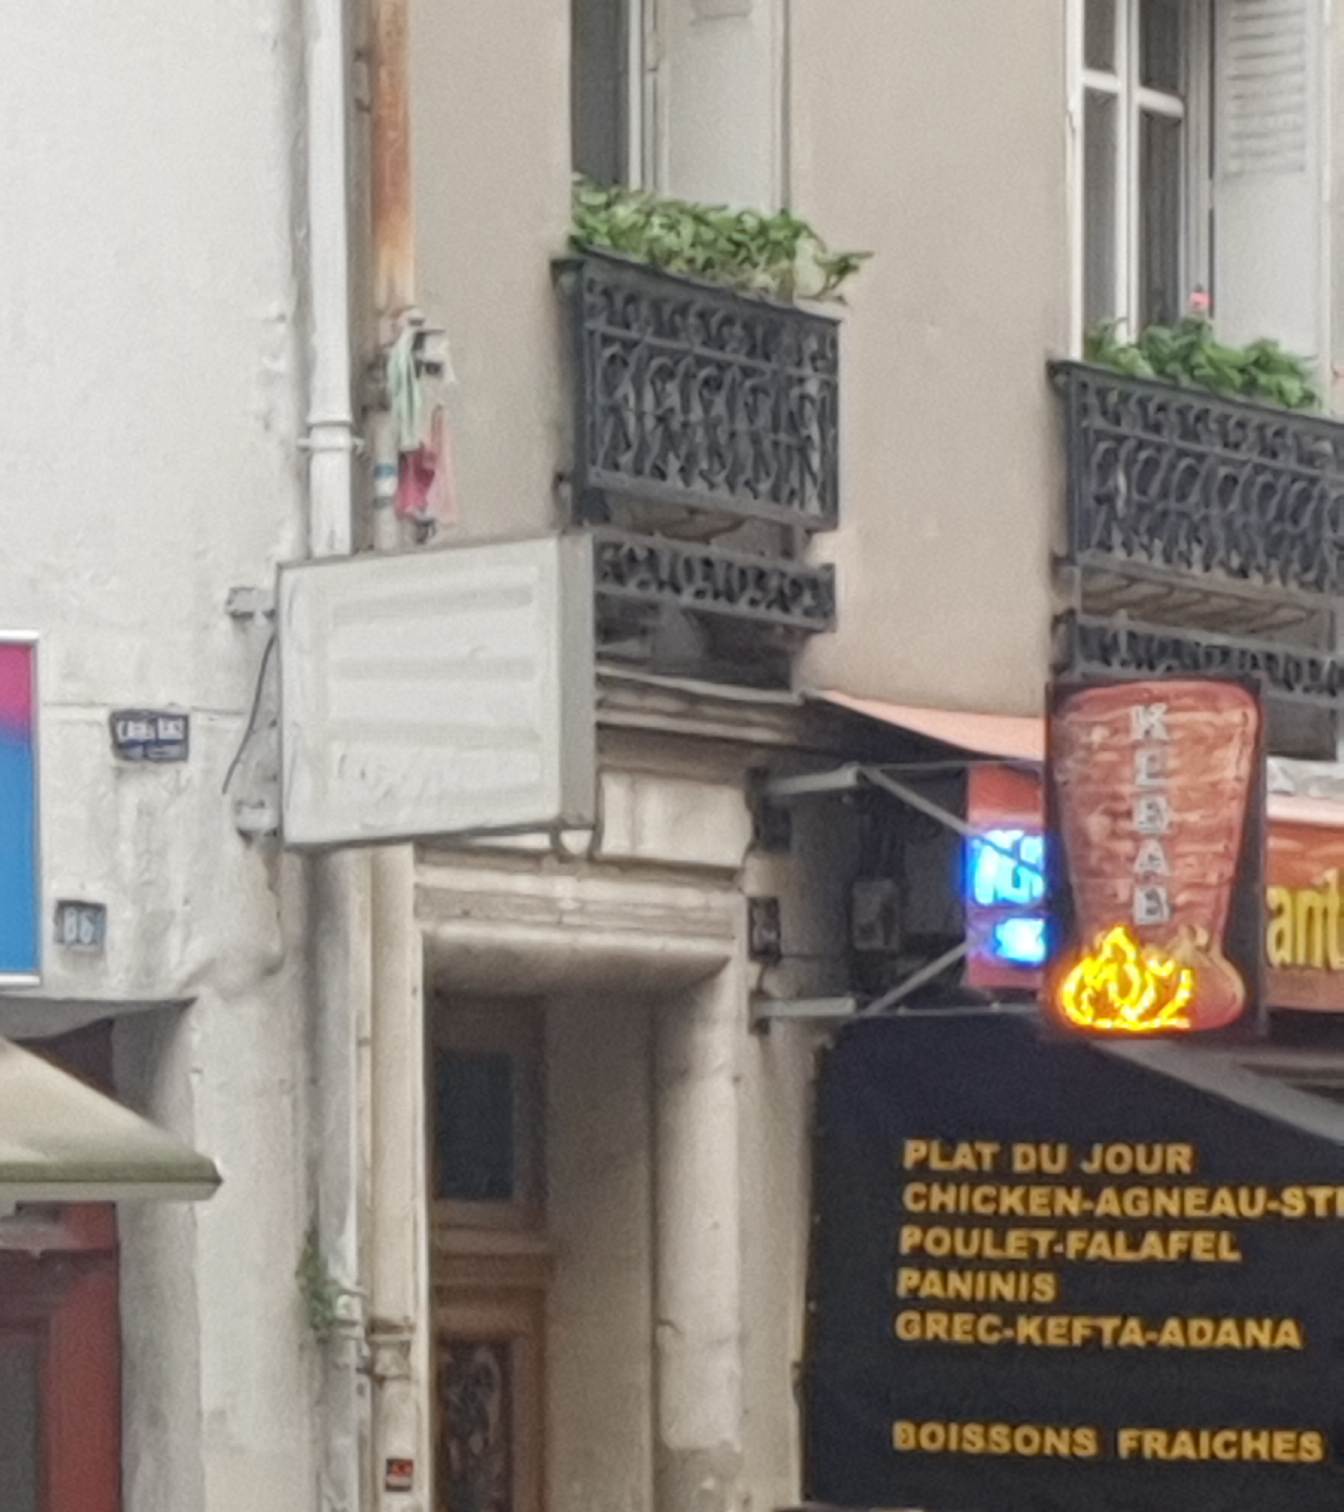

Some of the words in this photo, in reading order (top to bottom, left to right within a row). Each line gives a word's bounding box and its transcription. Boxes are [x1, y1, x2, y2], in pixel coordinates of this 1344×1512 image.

[1266, 868, 1344, 970] ant
[904, 1139, 1001, 1171] PLAT
[1012, 1142, 1069, 1173] DU
[1080, 1142, 1195, 1175] JOUR
[898, 1224, 1242, 1262] POULET-FALAFEL
[896, 1267, 1057, 1303] PANINIS
[894, 1310, 1304, 1350] GREC-KEFTA-ADANA
[891, 1421, 1100, 1457] BOISSONS
[1116, 1428, 1325, 1462] FRAICHES
